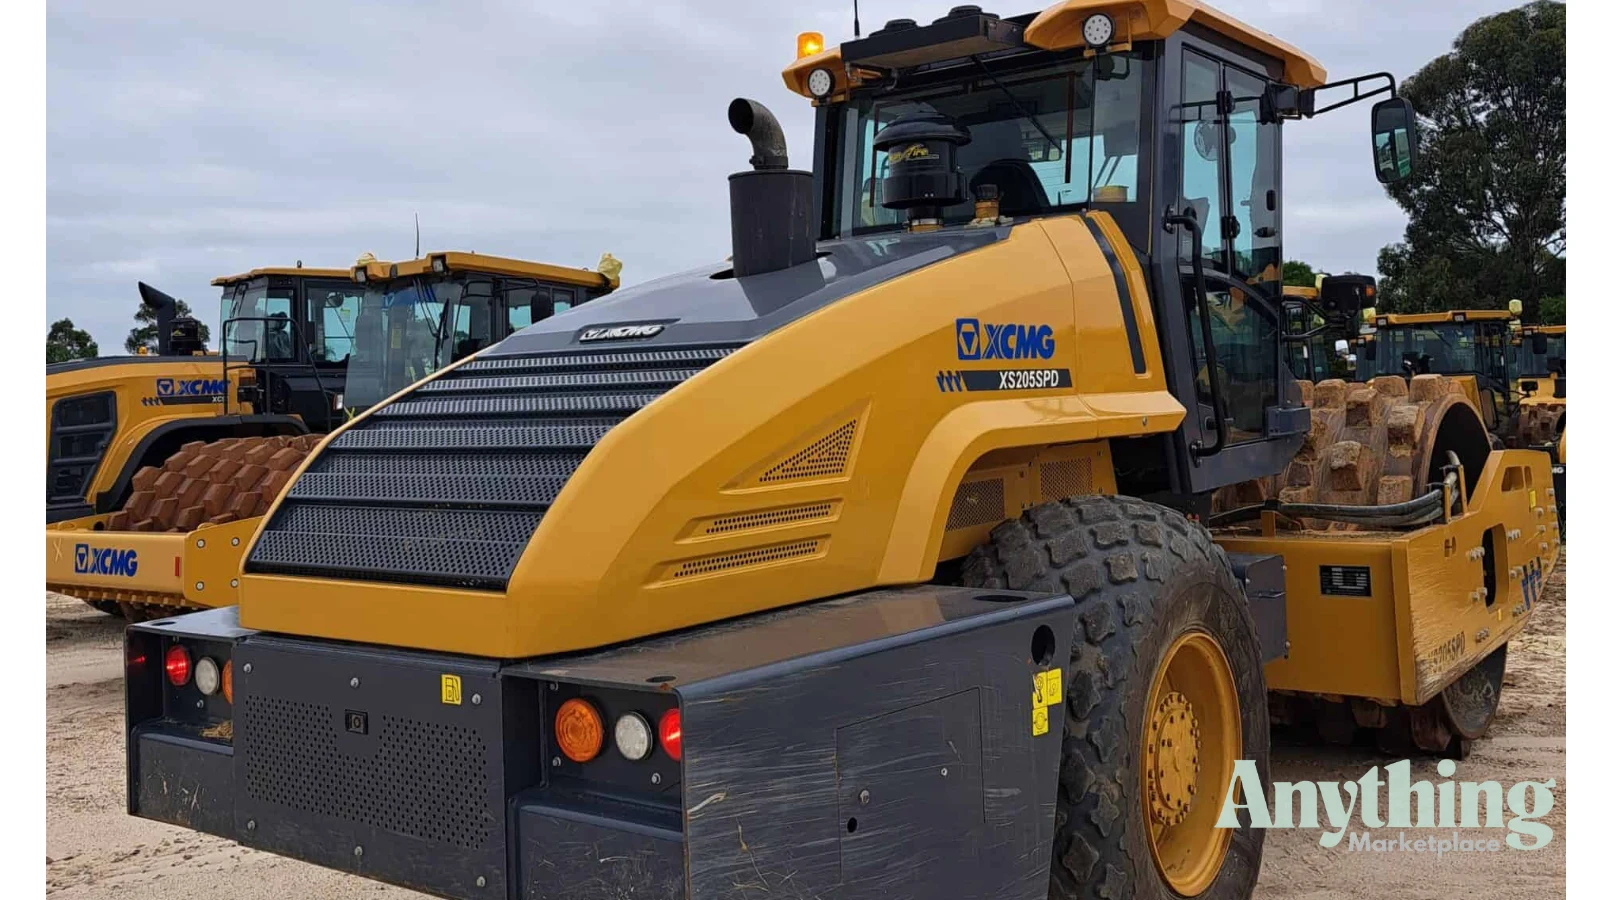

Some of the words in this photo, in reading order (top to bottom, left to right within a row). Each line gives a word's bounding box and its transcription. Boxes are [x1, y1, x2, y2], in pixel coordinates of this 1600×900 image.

[981, 324, 1055, 360] XCMG
[999, 369, 1059, 389] XS205SPD
[90, 548, 137, 577] XCMG
